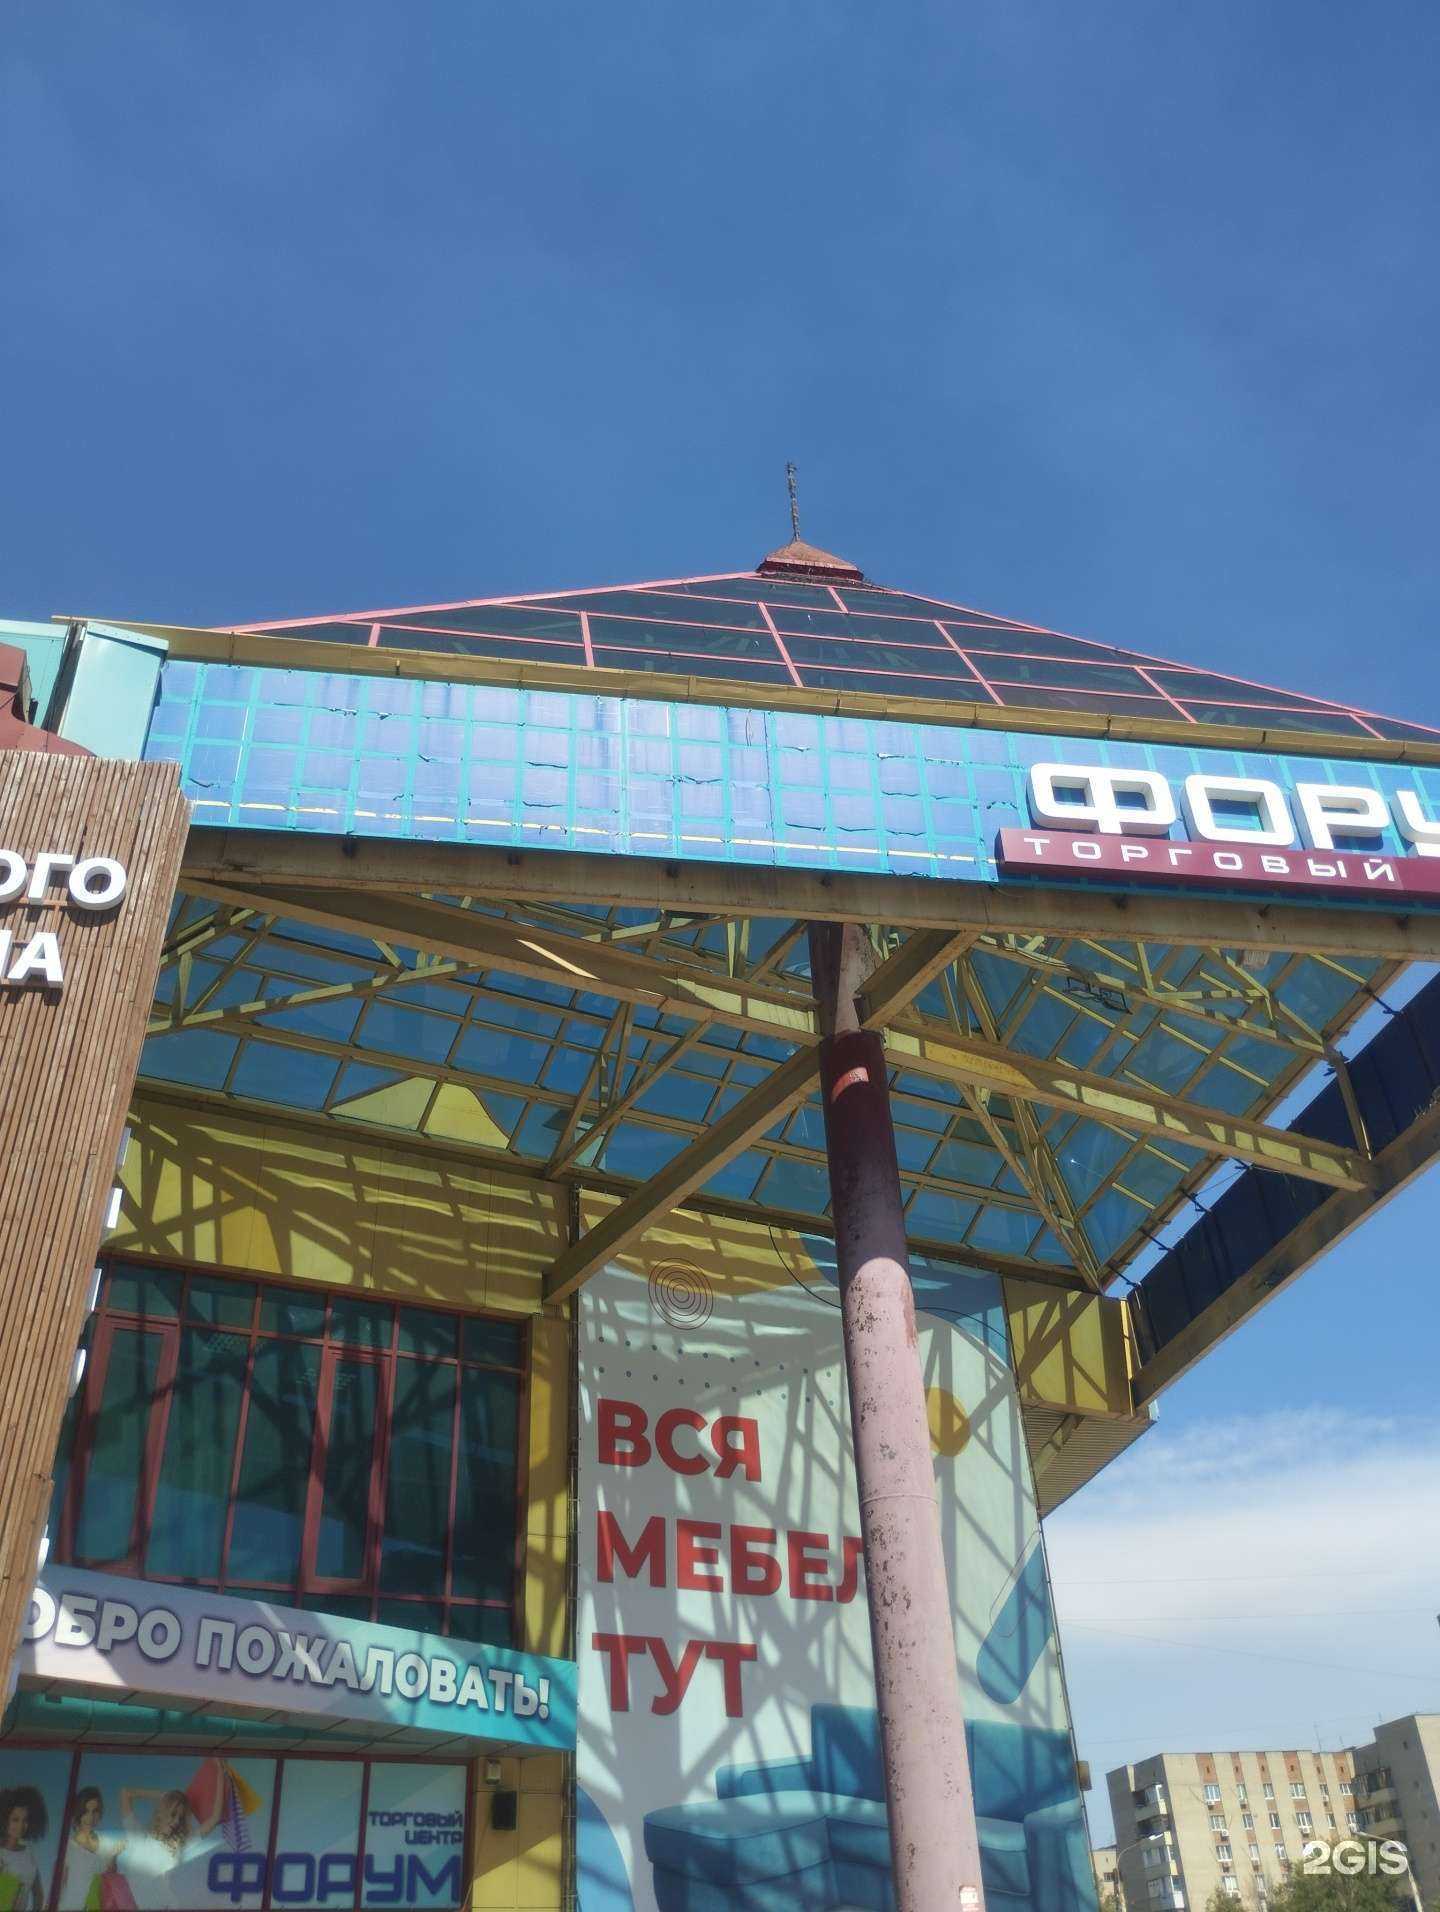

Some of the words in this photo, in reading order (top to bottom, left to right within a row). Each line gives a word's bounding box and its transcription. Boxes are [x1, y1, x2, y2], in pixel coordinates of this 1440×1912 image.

[1023, 836, 1396, 883] ТОРГОВЫЙ
[0, 929, 64, 988] А
[597, 1397, 762, 1483] ВСЯ
[195, 1617, 550, 1720] ПОЖАЛОВАТЬ!
[592, 1632, 758, 1718] ТУТ
[368, 1809, 464, 1828] ТОРГОВЫЙ
[404, 1829, 464, 1845] ЦЕНТР
[207, 1852, 462, 1904] ФОРУМ
